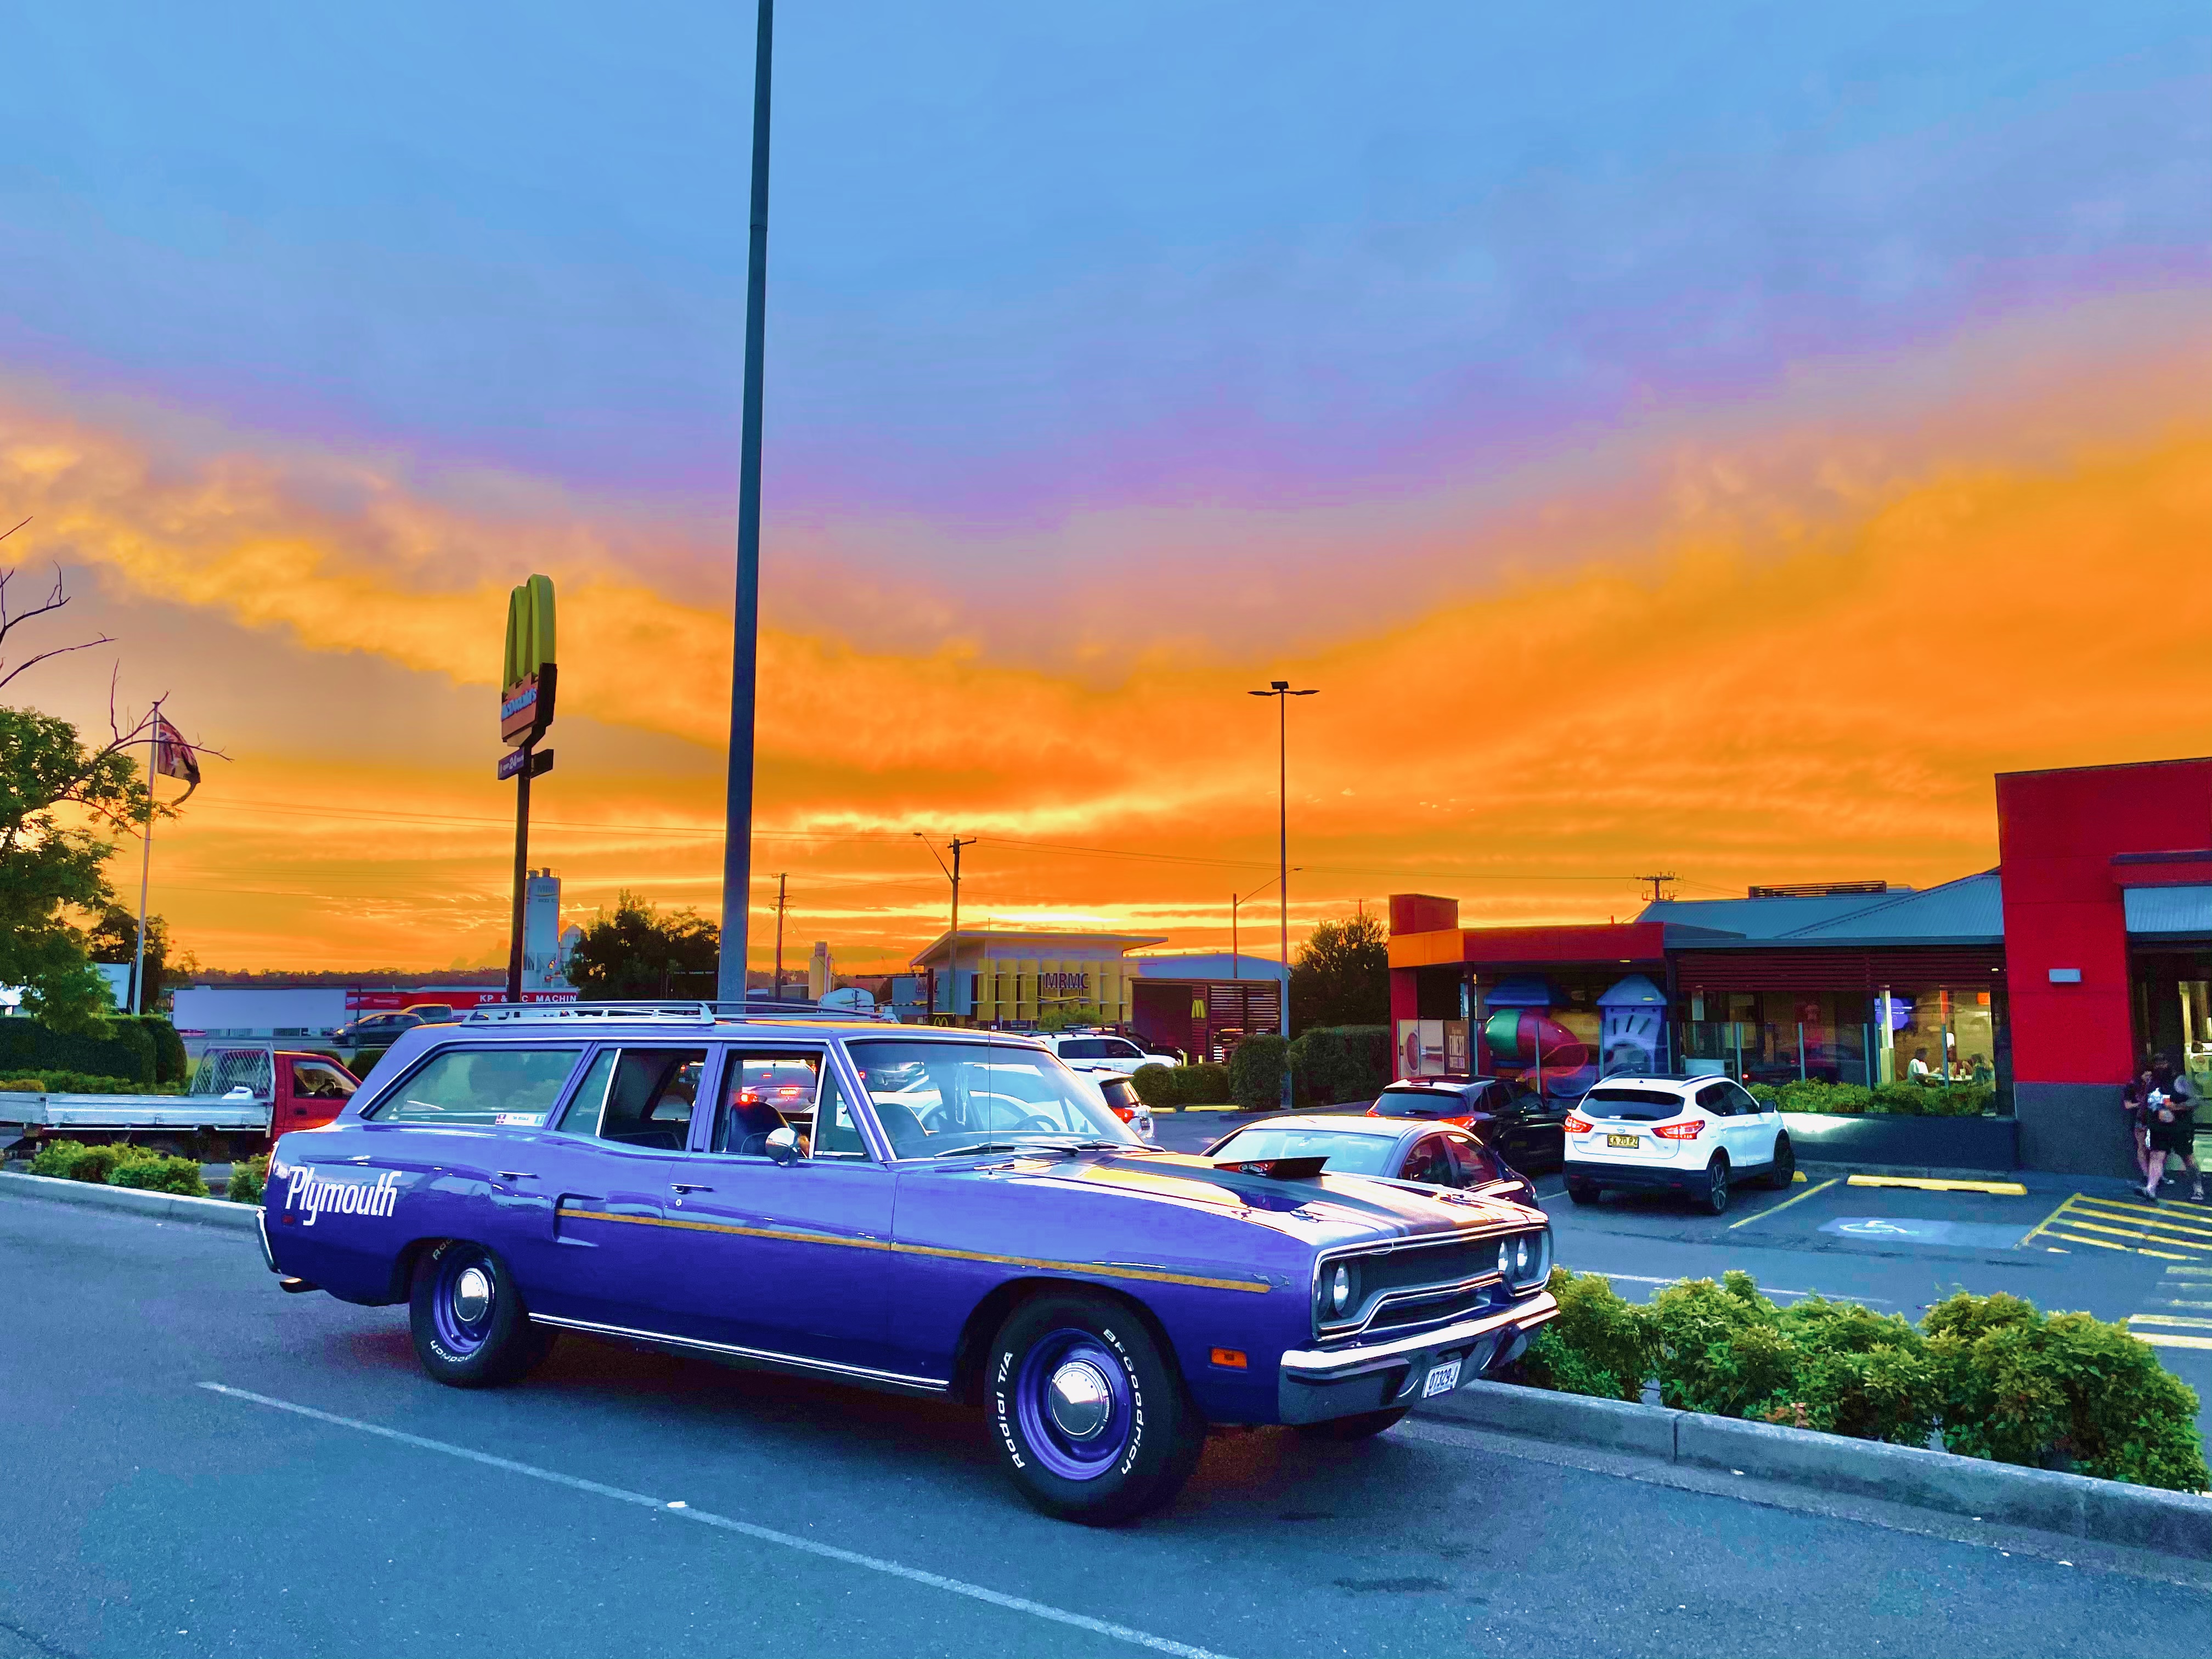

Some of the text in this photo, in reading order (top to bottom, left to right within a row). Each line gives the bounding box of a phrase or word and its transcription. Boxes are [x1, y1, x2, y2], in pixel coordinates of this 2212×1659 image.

[509, 755, 517, 770] 24
[1045, 973, 1089, 989] MRMC
[285, 1166, 402, 1226] Plymouth
[996, 1352, 1025, 1469] Radial T/A
[1103, 1328, 1144, 1475] BFGoodrich
